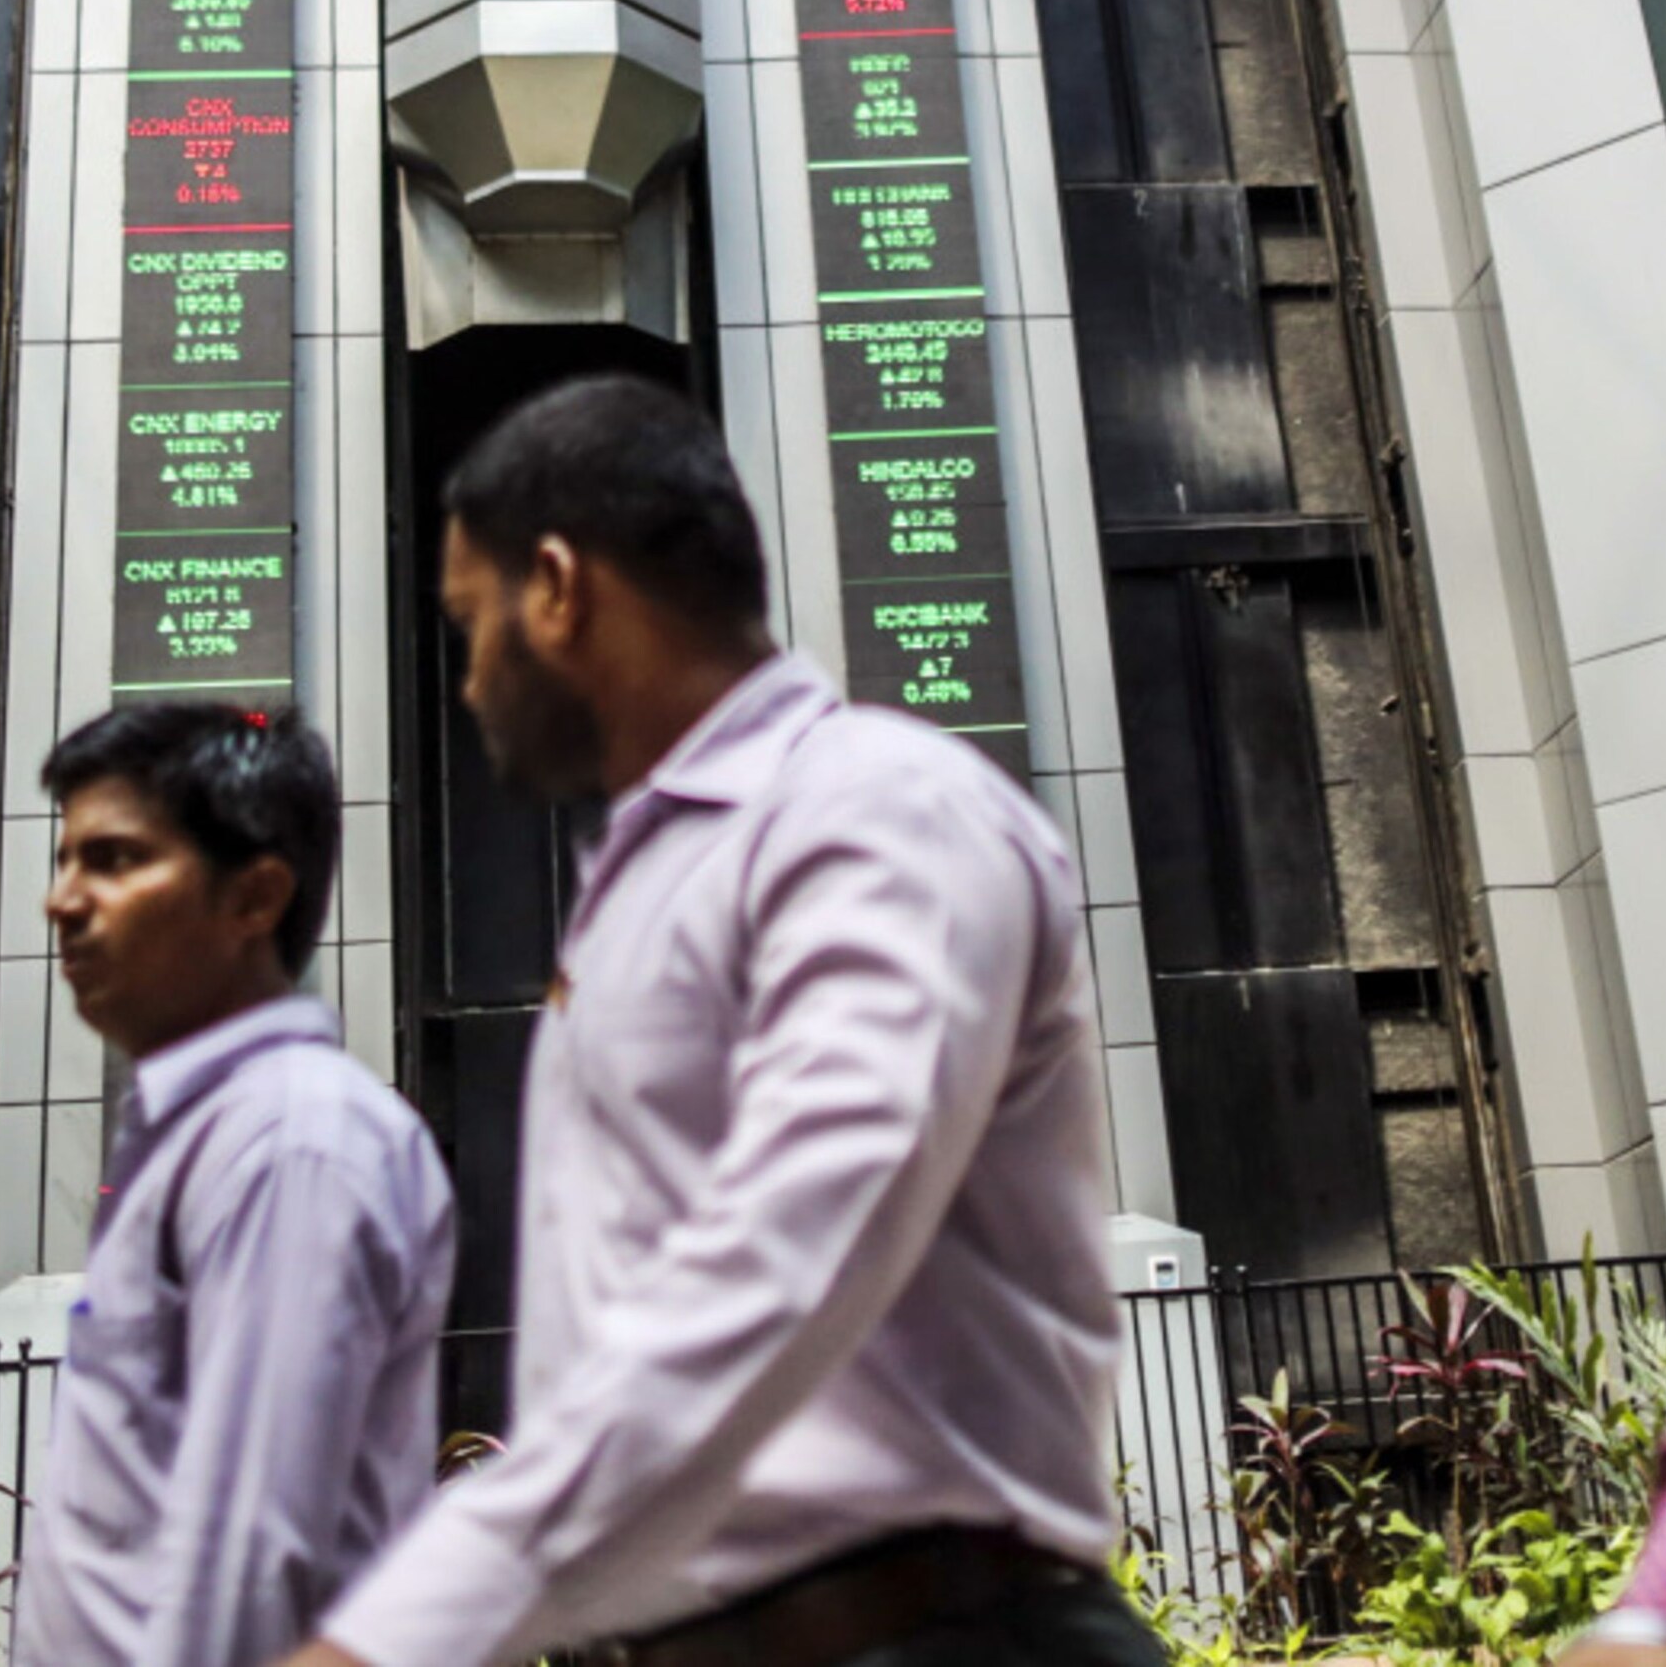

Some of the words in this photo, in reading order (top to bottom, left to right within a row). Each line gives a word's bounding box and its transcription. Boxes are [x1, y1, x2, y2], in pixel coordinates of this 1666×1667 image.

[185, 98, 235, 117] CNX
[127, 115, 291, 137] CONSUMPTION
[127, 251, 177, 274] CNX
[179, 248, 288, 272] DIVIDEND
[825, 317, 986, 341] HEROMOTOCO
[128, 413, 179, 435] CNX
[183, 409, 283, 434] ENERGY
[858, 456, 976, 482] HINDALCO
[124, 560, 177, 583] CNX
[179, 557, 283, 580] FINANCE
[873, 600, 990, 629] ICICIBANK
